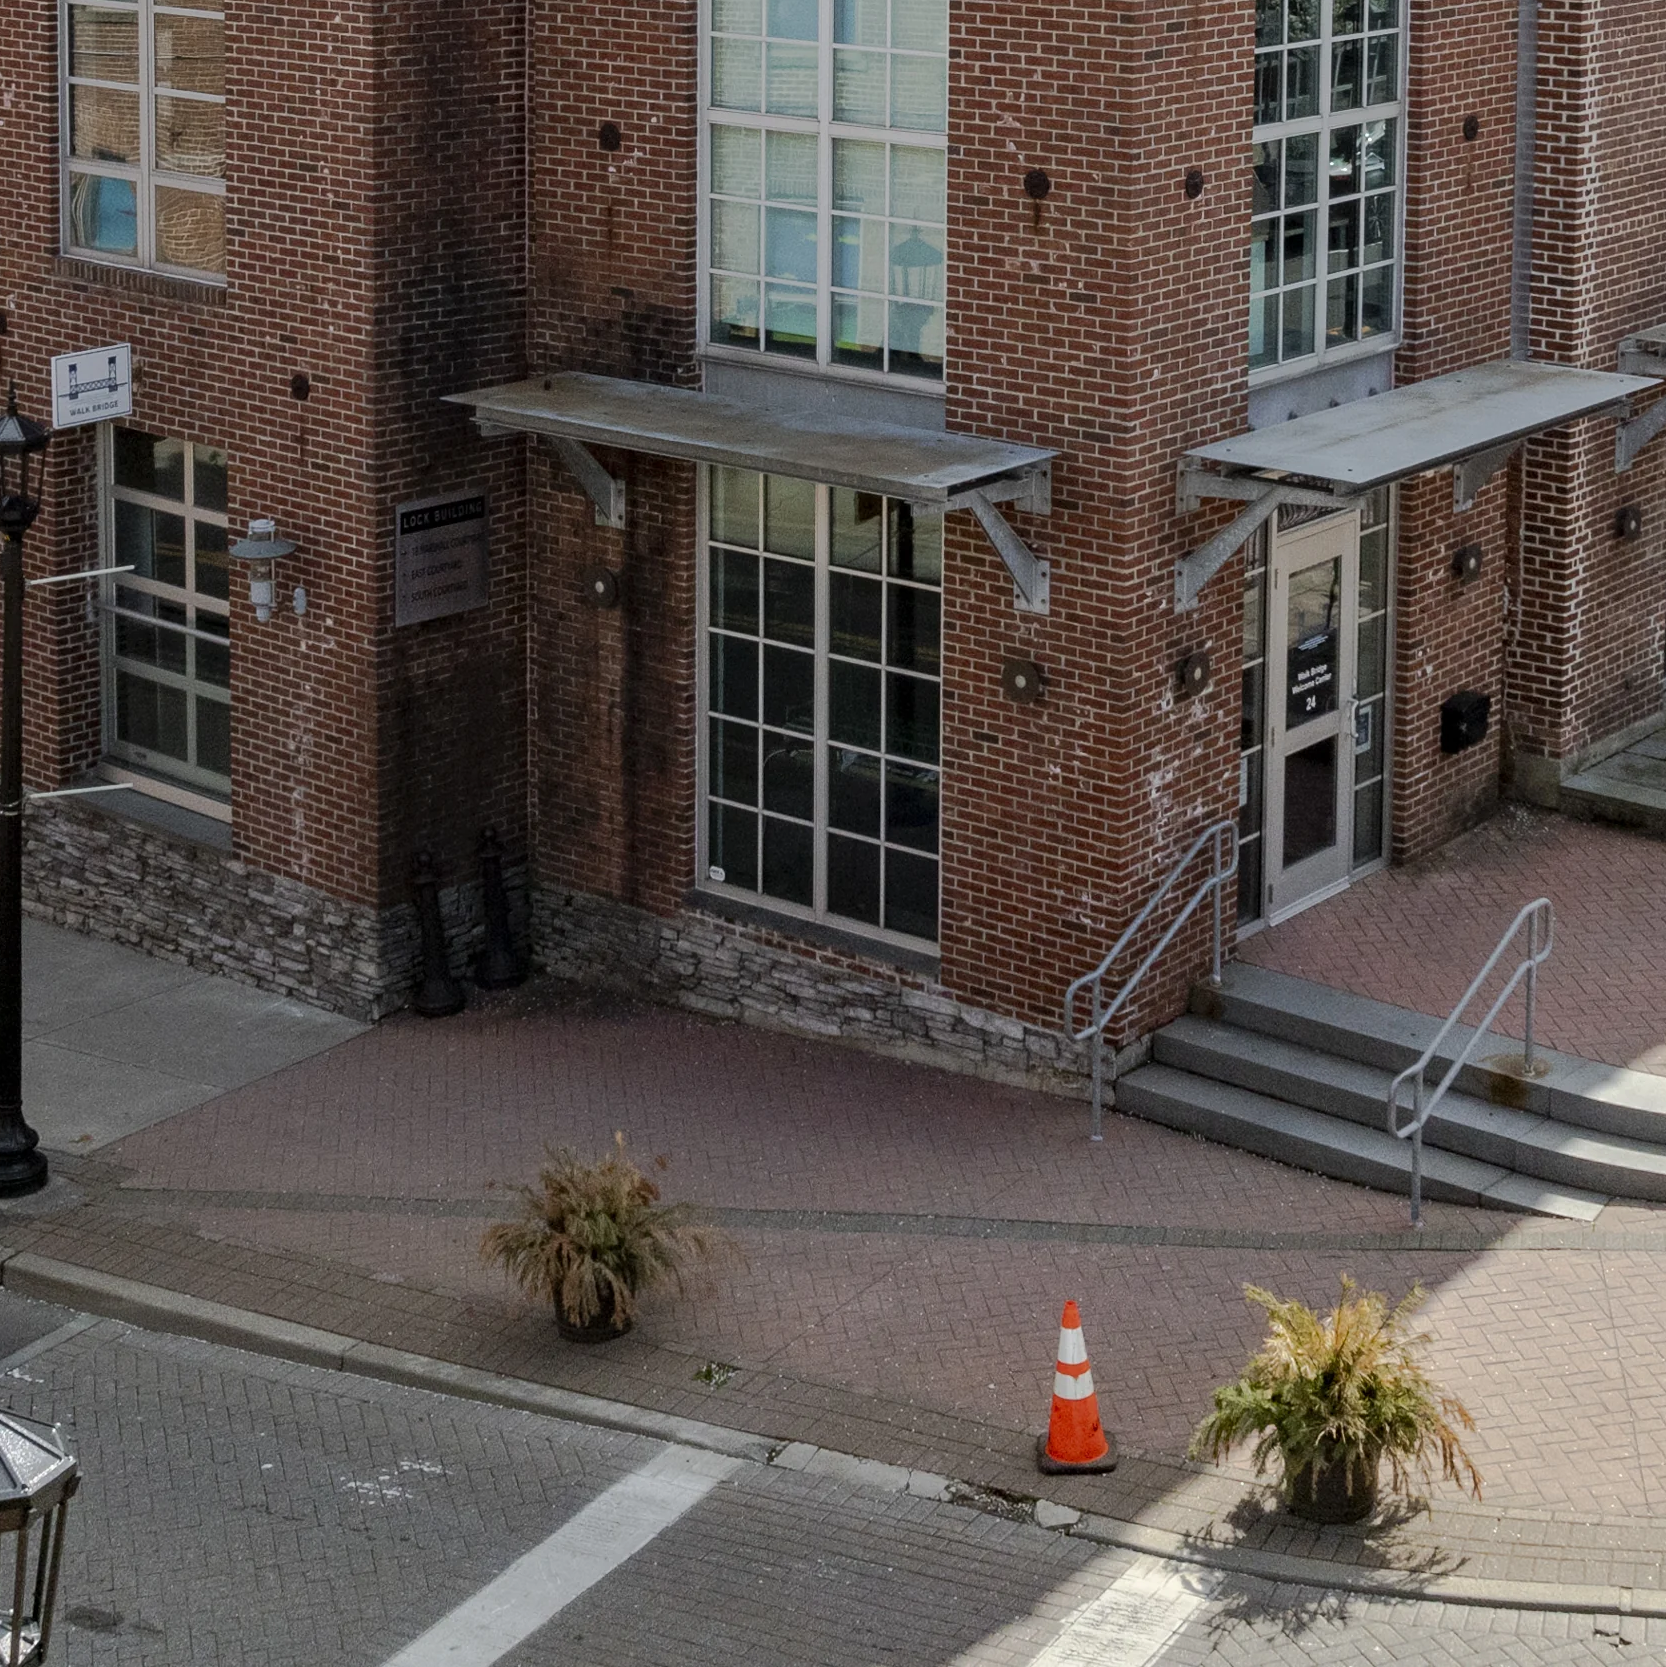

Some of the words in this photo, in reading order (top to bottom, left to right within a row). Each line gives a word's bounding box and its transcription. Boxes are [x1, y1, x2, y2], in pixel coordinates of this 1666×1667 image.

[69, 405, 90, 416] WALK
[92, 400, 119, 413] BRIDGE
[403, 512, 431, 529] LOCK
[434, 501, 483, 522] BUILDING
[411, 566, 426, 580] EAST
[411, 588, 433, 603] SOUTH
[1305, 694, 1317, 711] 24
